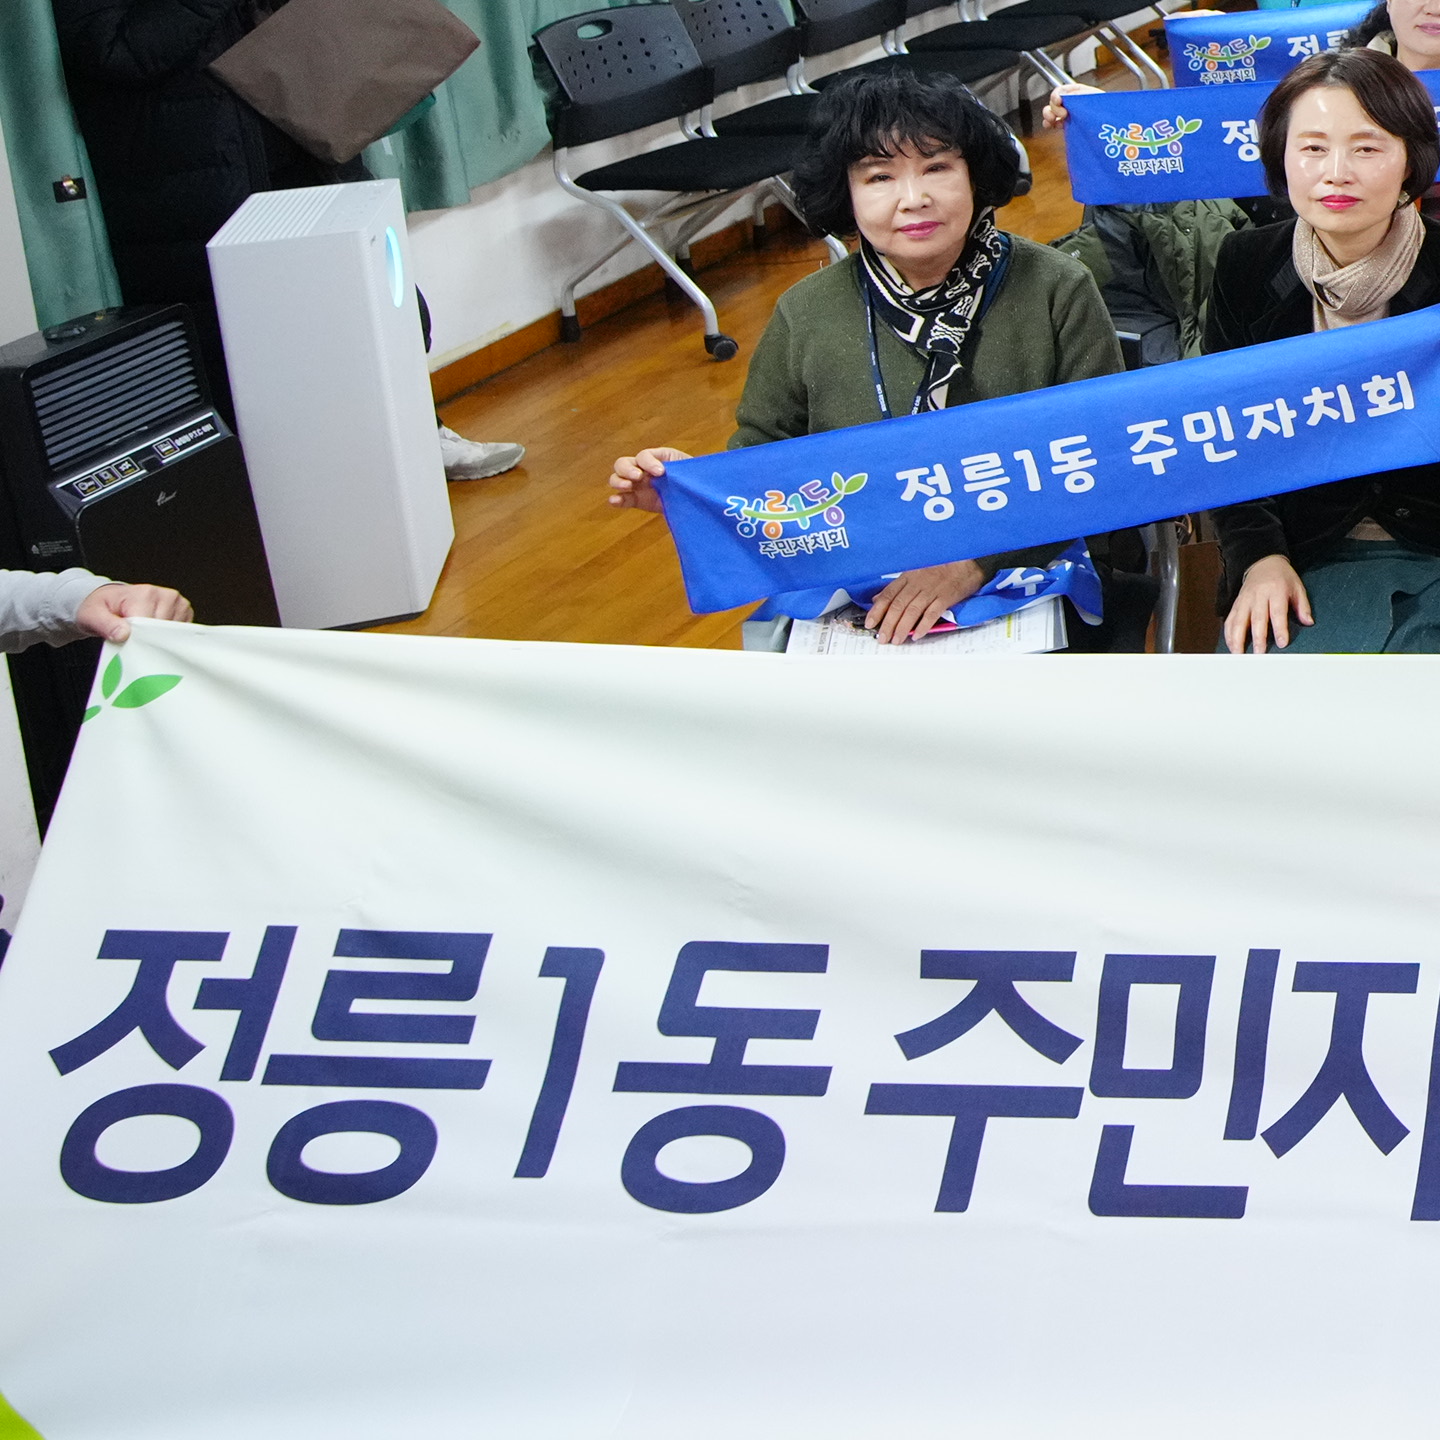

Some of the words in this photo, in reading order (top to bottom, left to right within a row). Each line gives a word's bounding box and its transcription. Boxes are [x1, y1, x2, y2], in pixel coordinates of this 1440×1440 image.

[1184, 36, 1253, 69] 정릉1동
[1099, 116, 1184, 160] 정릉1동
[1118, 157, 1184, 176] 주민자치회
[724, 478, 846, 540] 정릉1동
[896, 435, 1097, 521] 정릉1동
[1127, 371, 1414, 475] 주민자치회
[758, 527, 850, 561] 주민자치회
[47, 923, 833, 1216] 정릉1동
